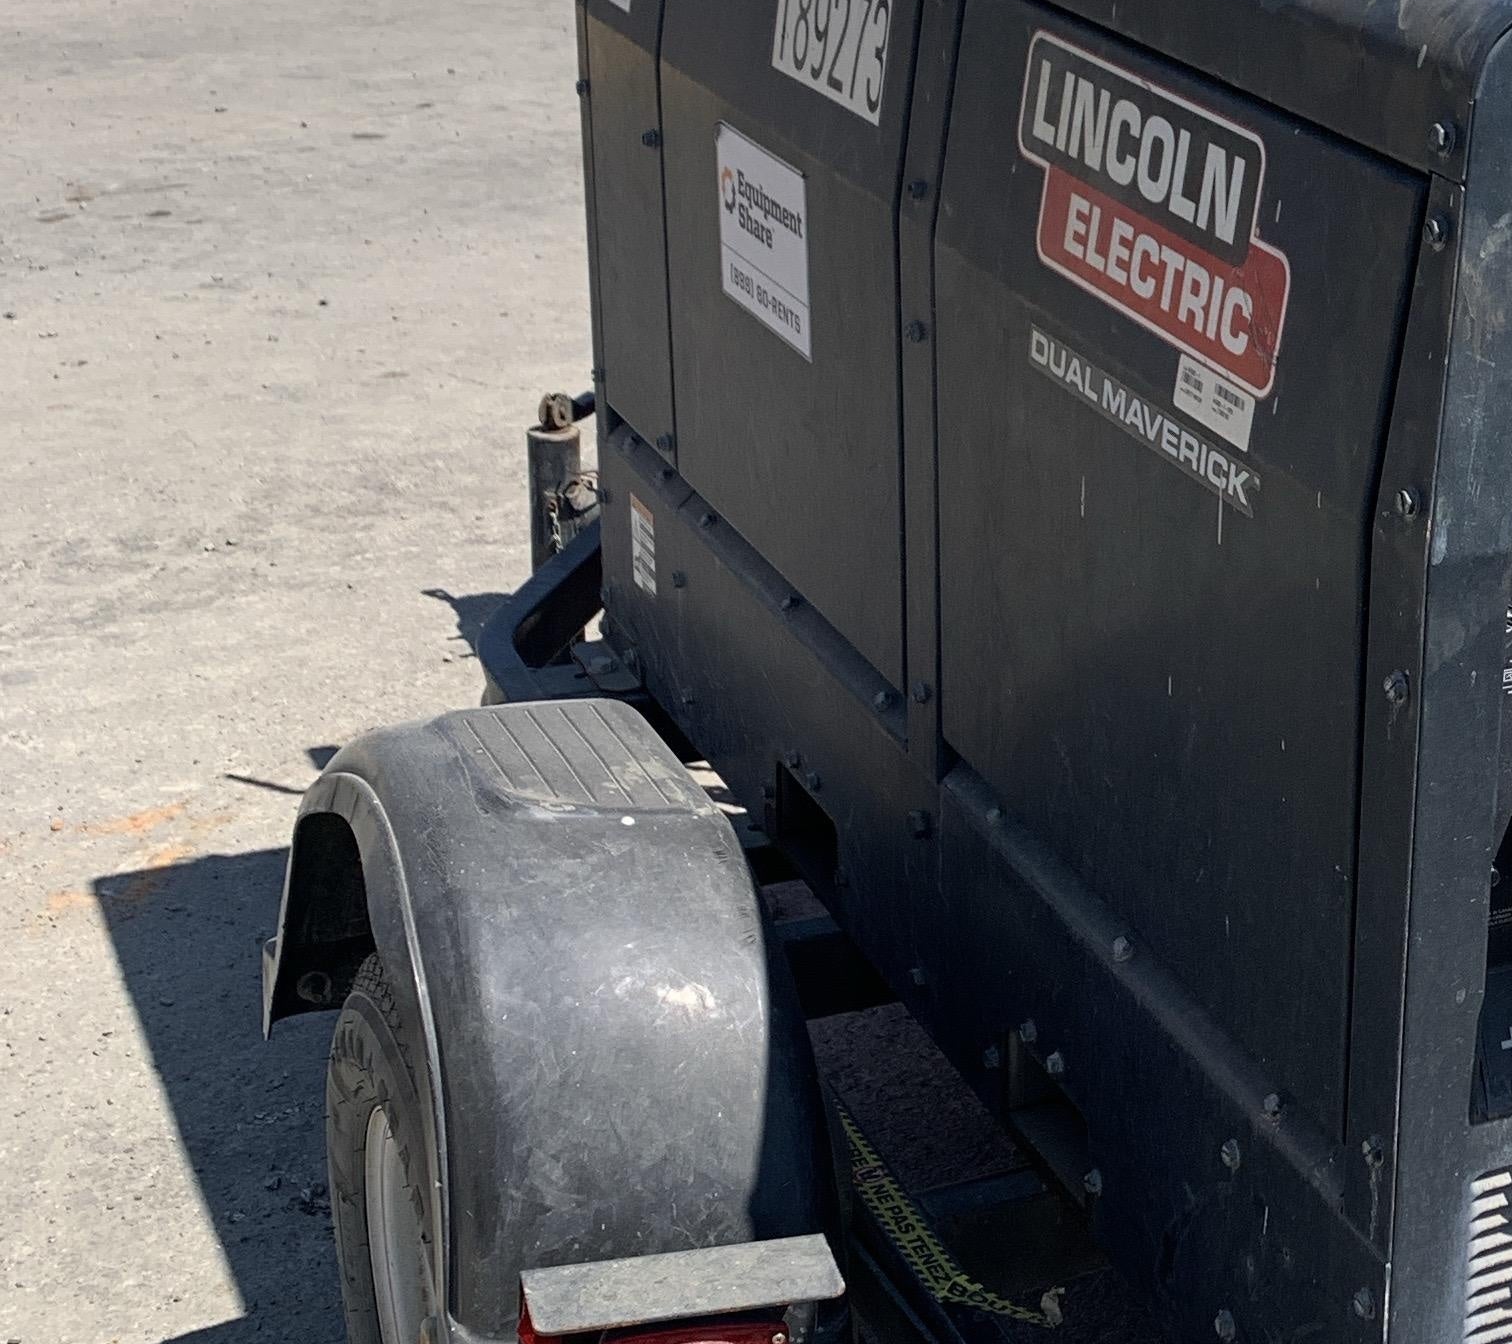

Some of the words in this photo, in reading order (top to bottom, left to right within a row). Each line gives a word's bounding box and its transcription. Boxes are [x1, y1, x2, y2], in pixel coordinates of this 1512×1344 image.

[736, 168, 804, 240] Equipment
[1031, 58, 1247, 246] LINCOLN
[738, 203, 774, 250] Share
[1063, 191, 1253, 357] ELECTRIC
[1030, 328, 1100, 403] DUAL
[1101, 378, 1250, 506] MAVERICK
[870, 1182, 896, 1206] NE
[890, 1205, 916, 1236] PAS
[906, 1234, 951, 1286] TENEZ
